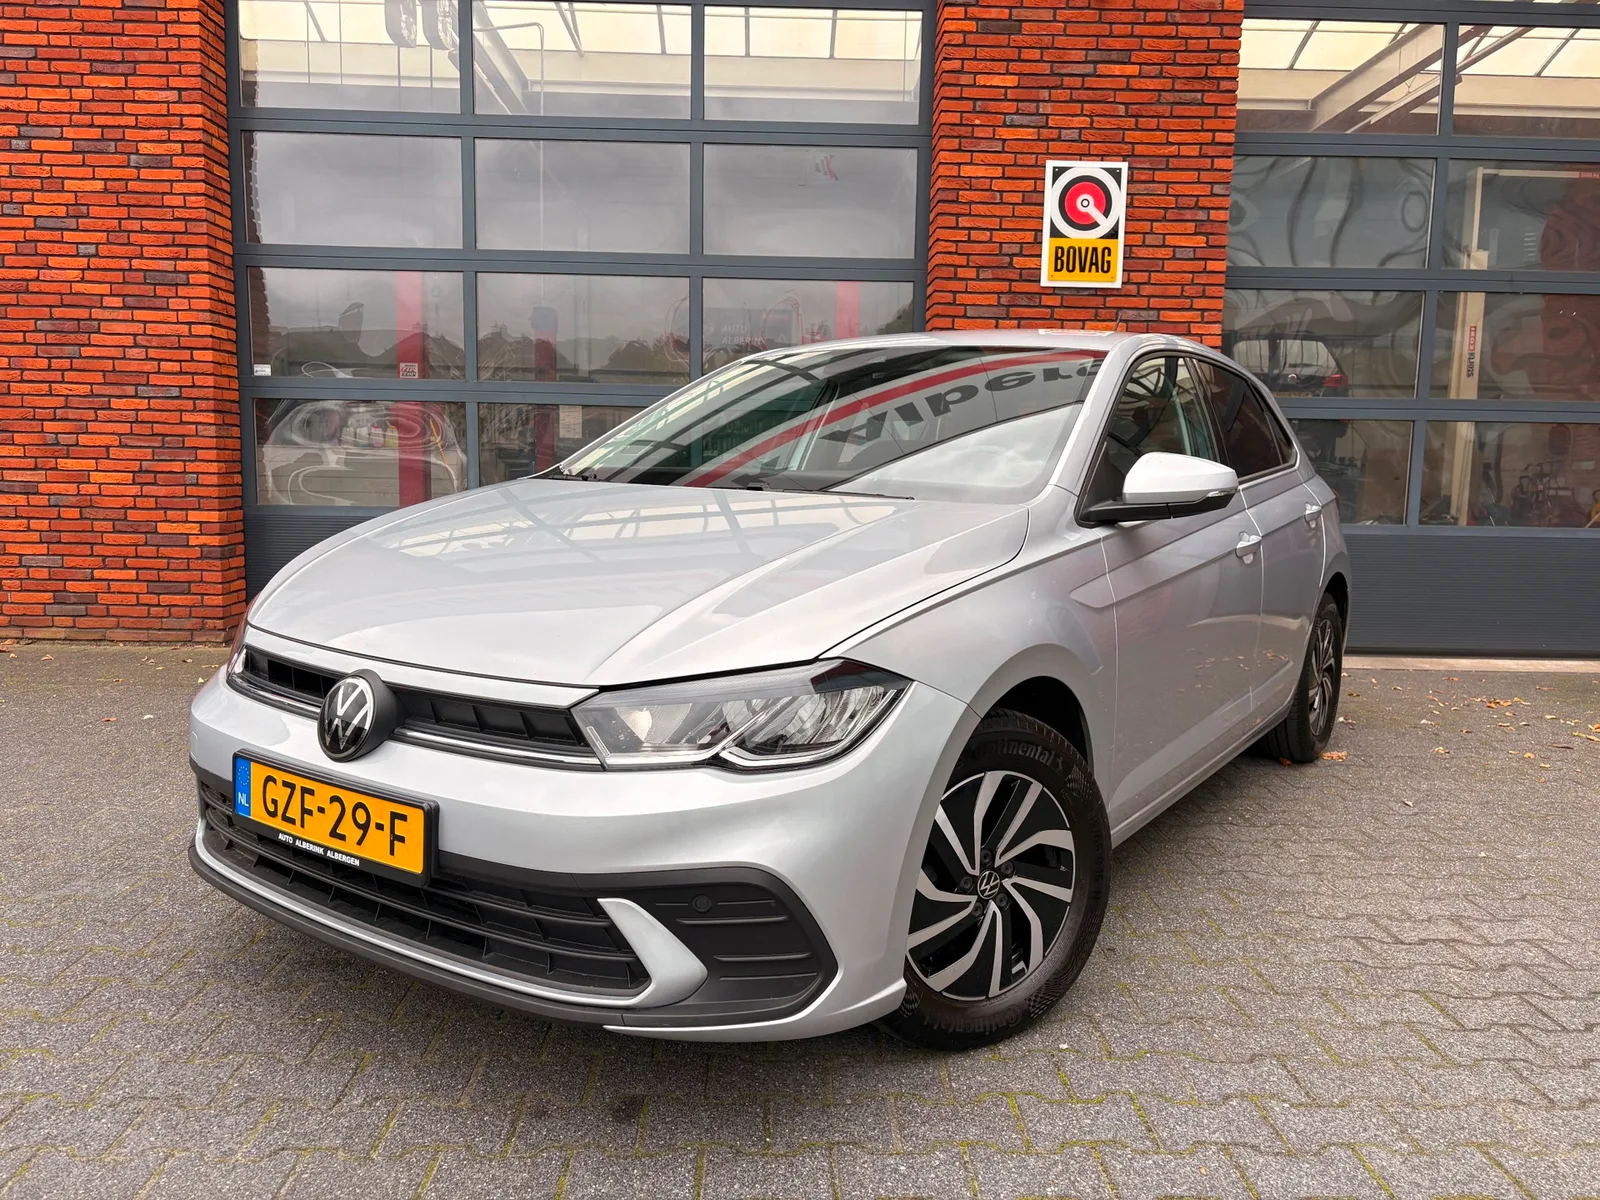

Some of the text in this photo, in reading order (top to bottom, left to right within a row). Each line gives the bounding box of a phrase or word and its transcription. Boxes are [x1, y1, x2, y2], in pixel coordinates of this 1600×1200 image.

[1054, 245, 1112, 274] BOVAG
[238, 774, 408, 857] NL GZF-29-F
[278, 832, 360, 867] AUTO ALBERINK ALBERGEN
